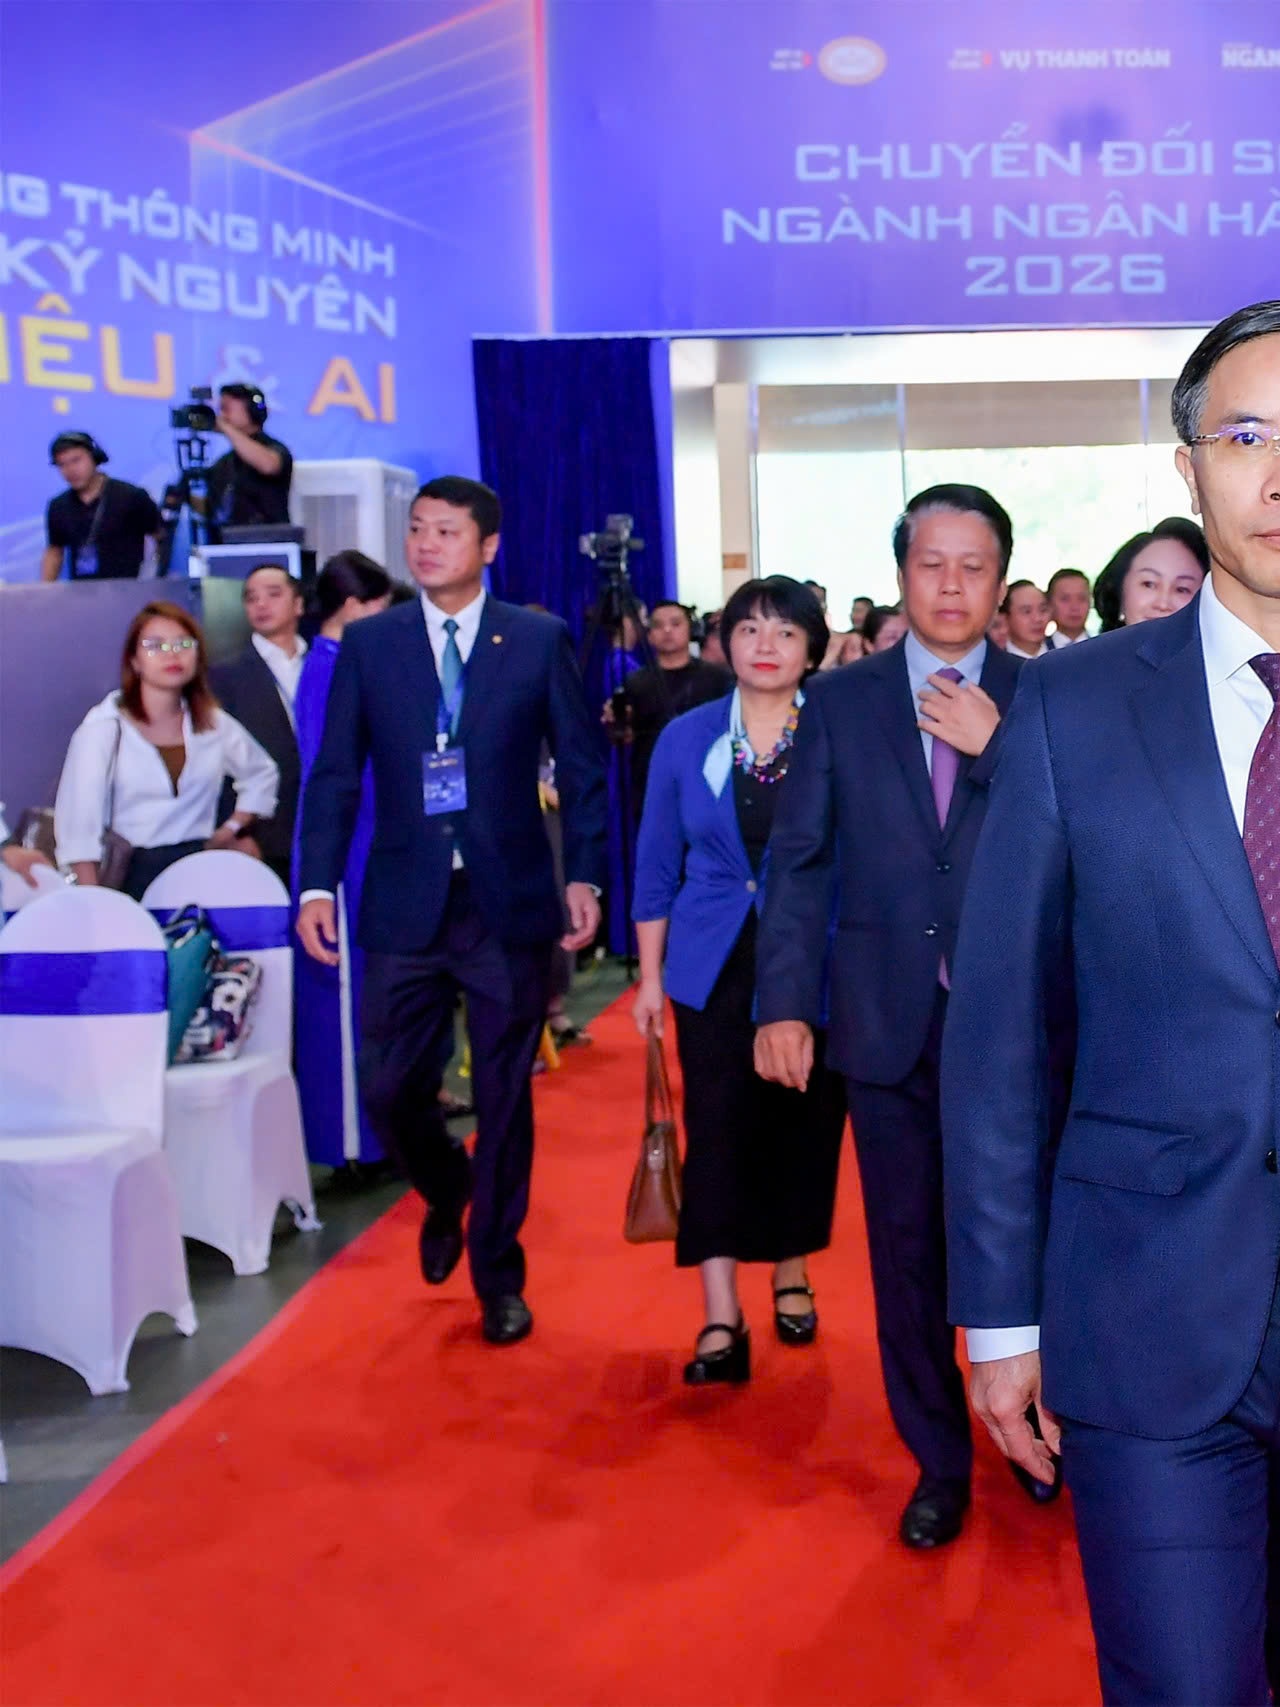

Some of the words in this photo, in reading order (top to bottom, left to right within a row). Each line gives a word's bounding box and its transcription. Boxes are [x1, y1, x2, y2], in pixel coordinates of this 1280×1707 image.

[1035, 48, 1108, 68] THANH
[0, 170, 49, 219] G
[60, 182, 259, 253] THÔNG
[272, 221, 396, 278] MINH
[722, 192, 972, 243] NGÀNH
[992, 189, 1187, 240] NGÂN
[117, 252, 397, 339] NGUYÊN
[964, 253, 1167, 297] 2026
[308, 355, 397, 424] AI
